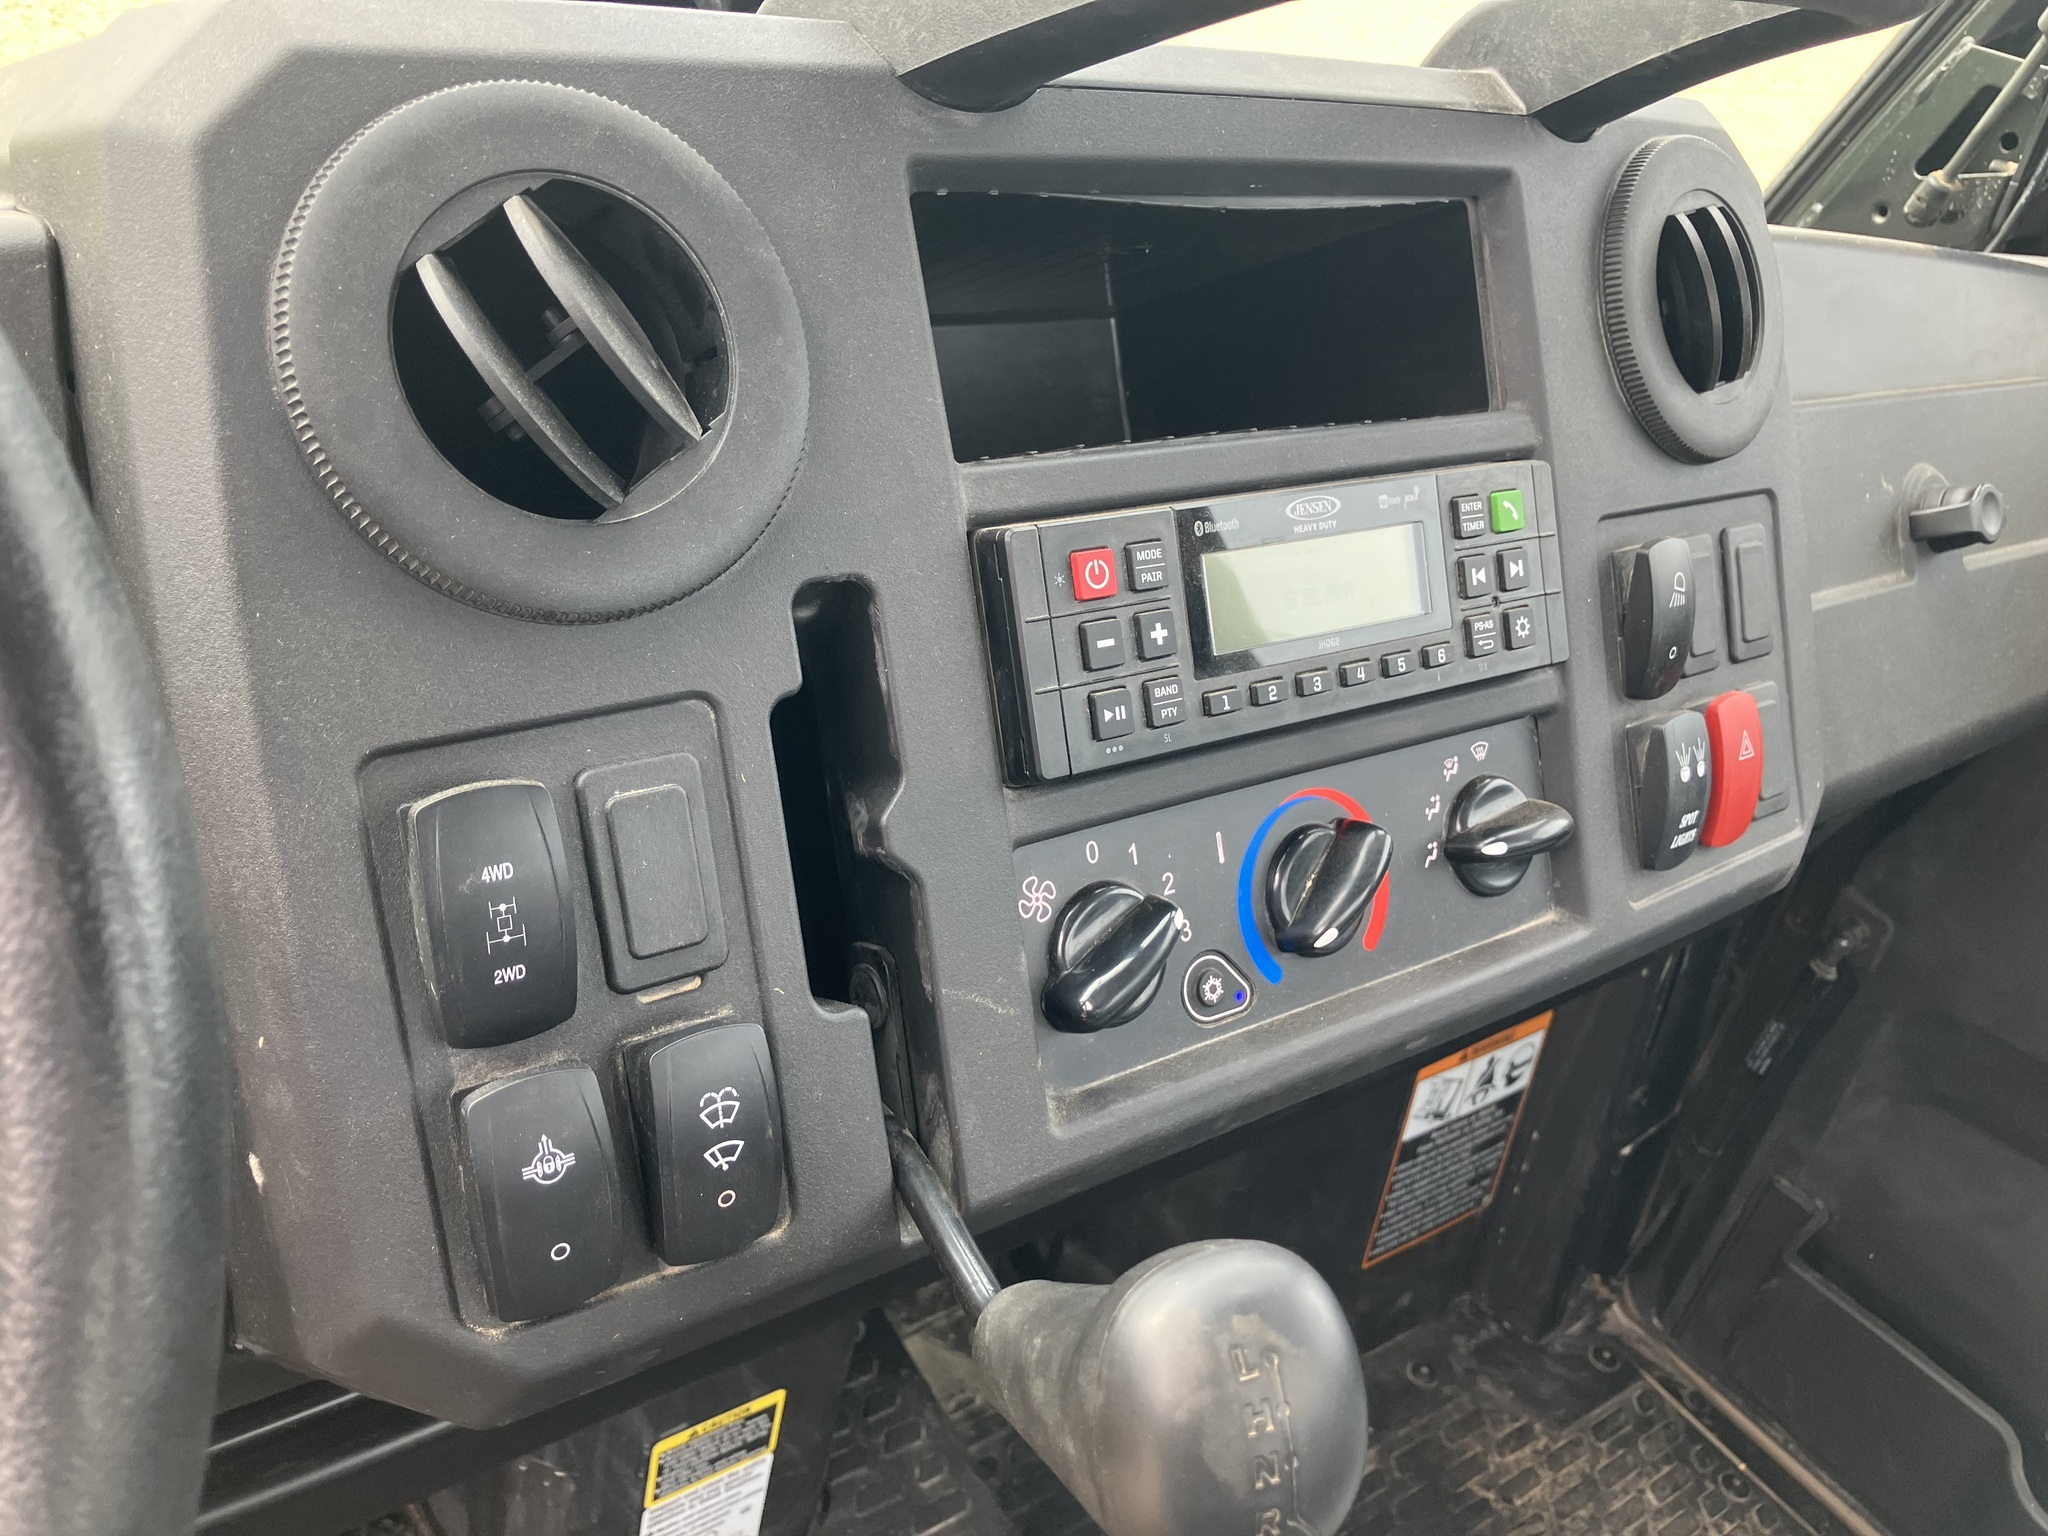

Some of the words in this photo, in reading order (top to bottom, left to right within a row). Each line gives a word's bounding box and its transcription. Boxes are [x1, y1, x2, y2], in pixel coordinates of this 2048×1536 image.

[1293, 499, 1332, 517] JENSEN
[1461, 501, 1482, 512] ENTER
[1204, 518, 1240, 534] Bluetooth
[1293, 522, 1317, 534] HEAVY
[1318, 519, 1337, 531] DUTY
[1462, 520, 1485, 532] TIMER
[1136, 548, 1162, 562] MODE
[1141, 571, 1163, 583] PAIR
[1438, 649, 1446, 663] 6
[1397, 658, 1406, 672] 5
[1356, 666, 1366, 681] 4
[1154, 684, 1179, 698] BAND
[1313, 676, 1322, 692] 3
[1268, 685, 1278, 701] 2
[1222, 695, 1231, 711] 1
[1160, 706, 1178, 719] PTY
[1679, 809, 1699, 829] SPOT
[1669, 828, 1697, 849] LIGHTS
[1085, 840, 1099, 864] 0
[1128, 842, 1138, 865] 1
[481, 862, 514, 883] 4WD
[1162, 872, 1176, 896] 2
[1180, 919, 1192, 942] 3
[493, 964, 526, 985] 2WD
[1230, 1345, 1260, 1381] L
[1243, 1397, 1275, 1438] H
[1255, 1451, 1280, 1490] N
